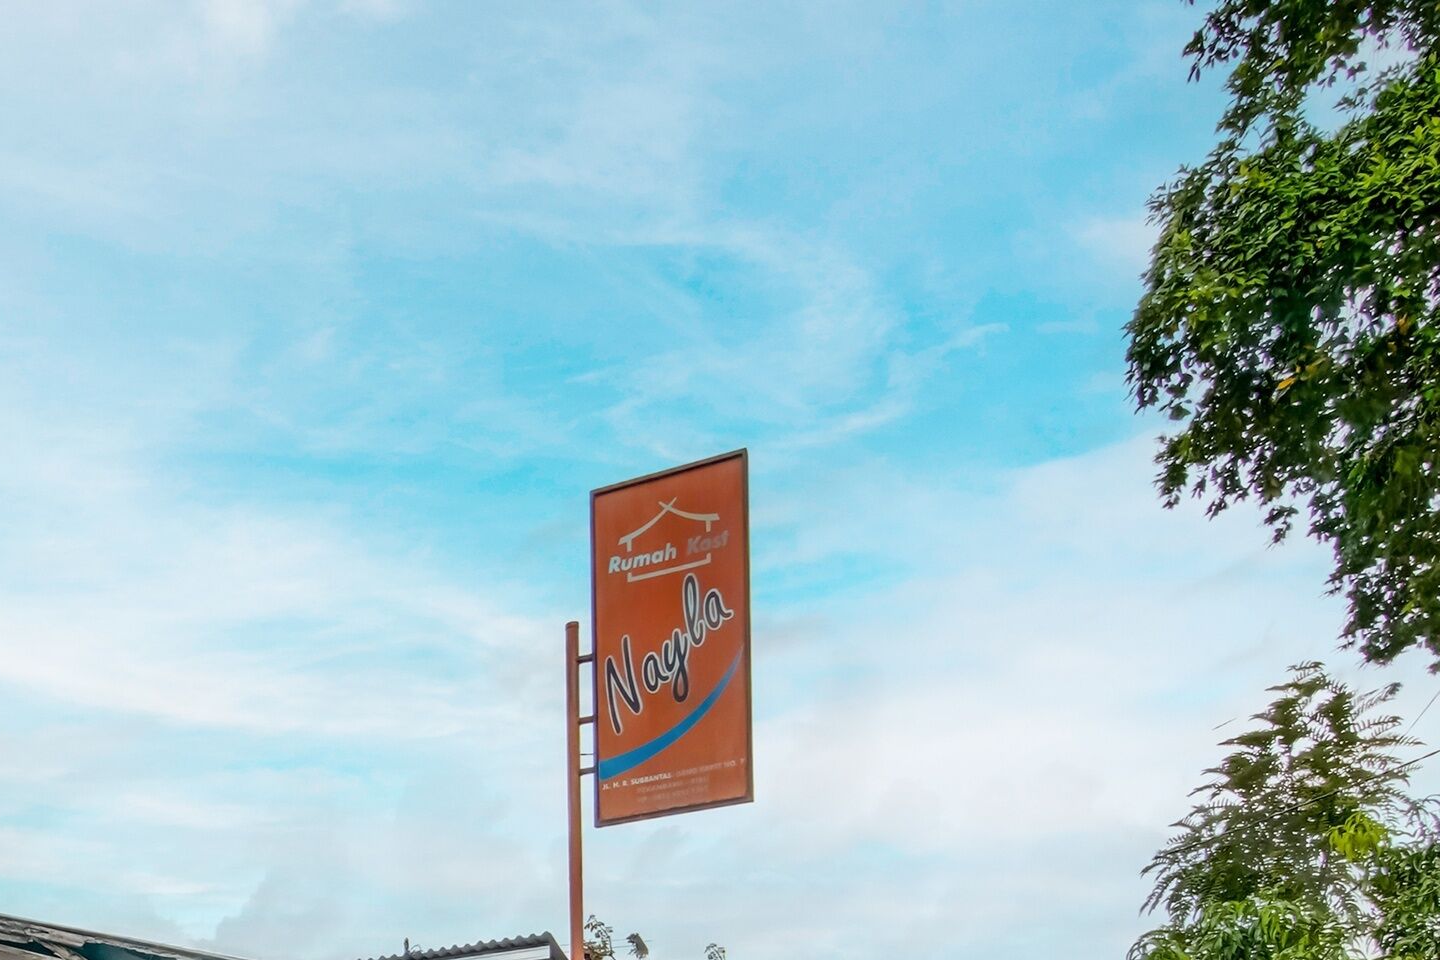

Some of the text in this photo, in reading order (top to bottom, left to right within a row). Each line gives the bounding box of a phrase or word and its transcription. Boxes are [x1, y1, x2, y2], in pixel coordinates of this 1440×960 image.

[608, 530, 729, 574] Rumah Kost
[605, 572, 734, 735] Nayla
